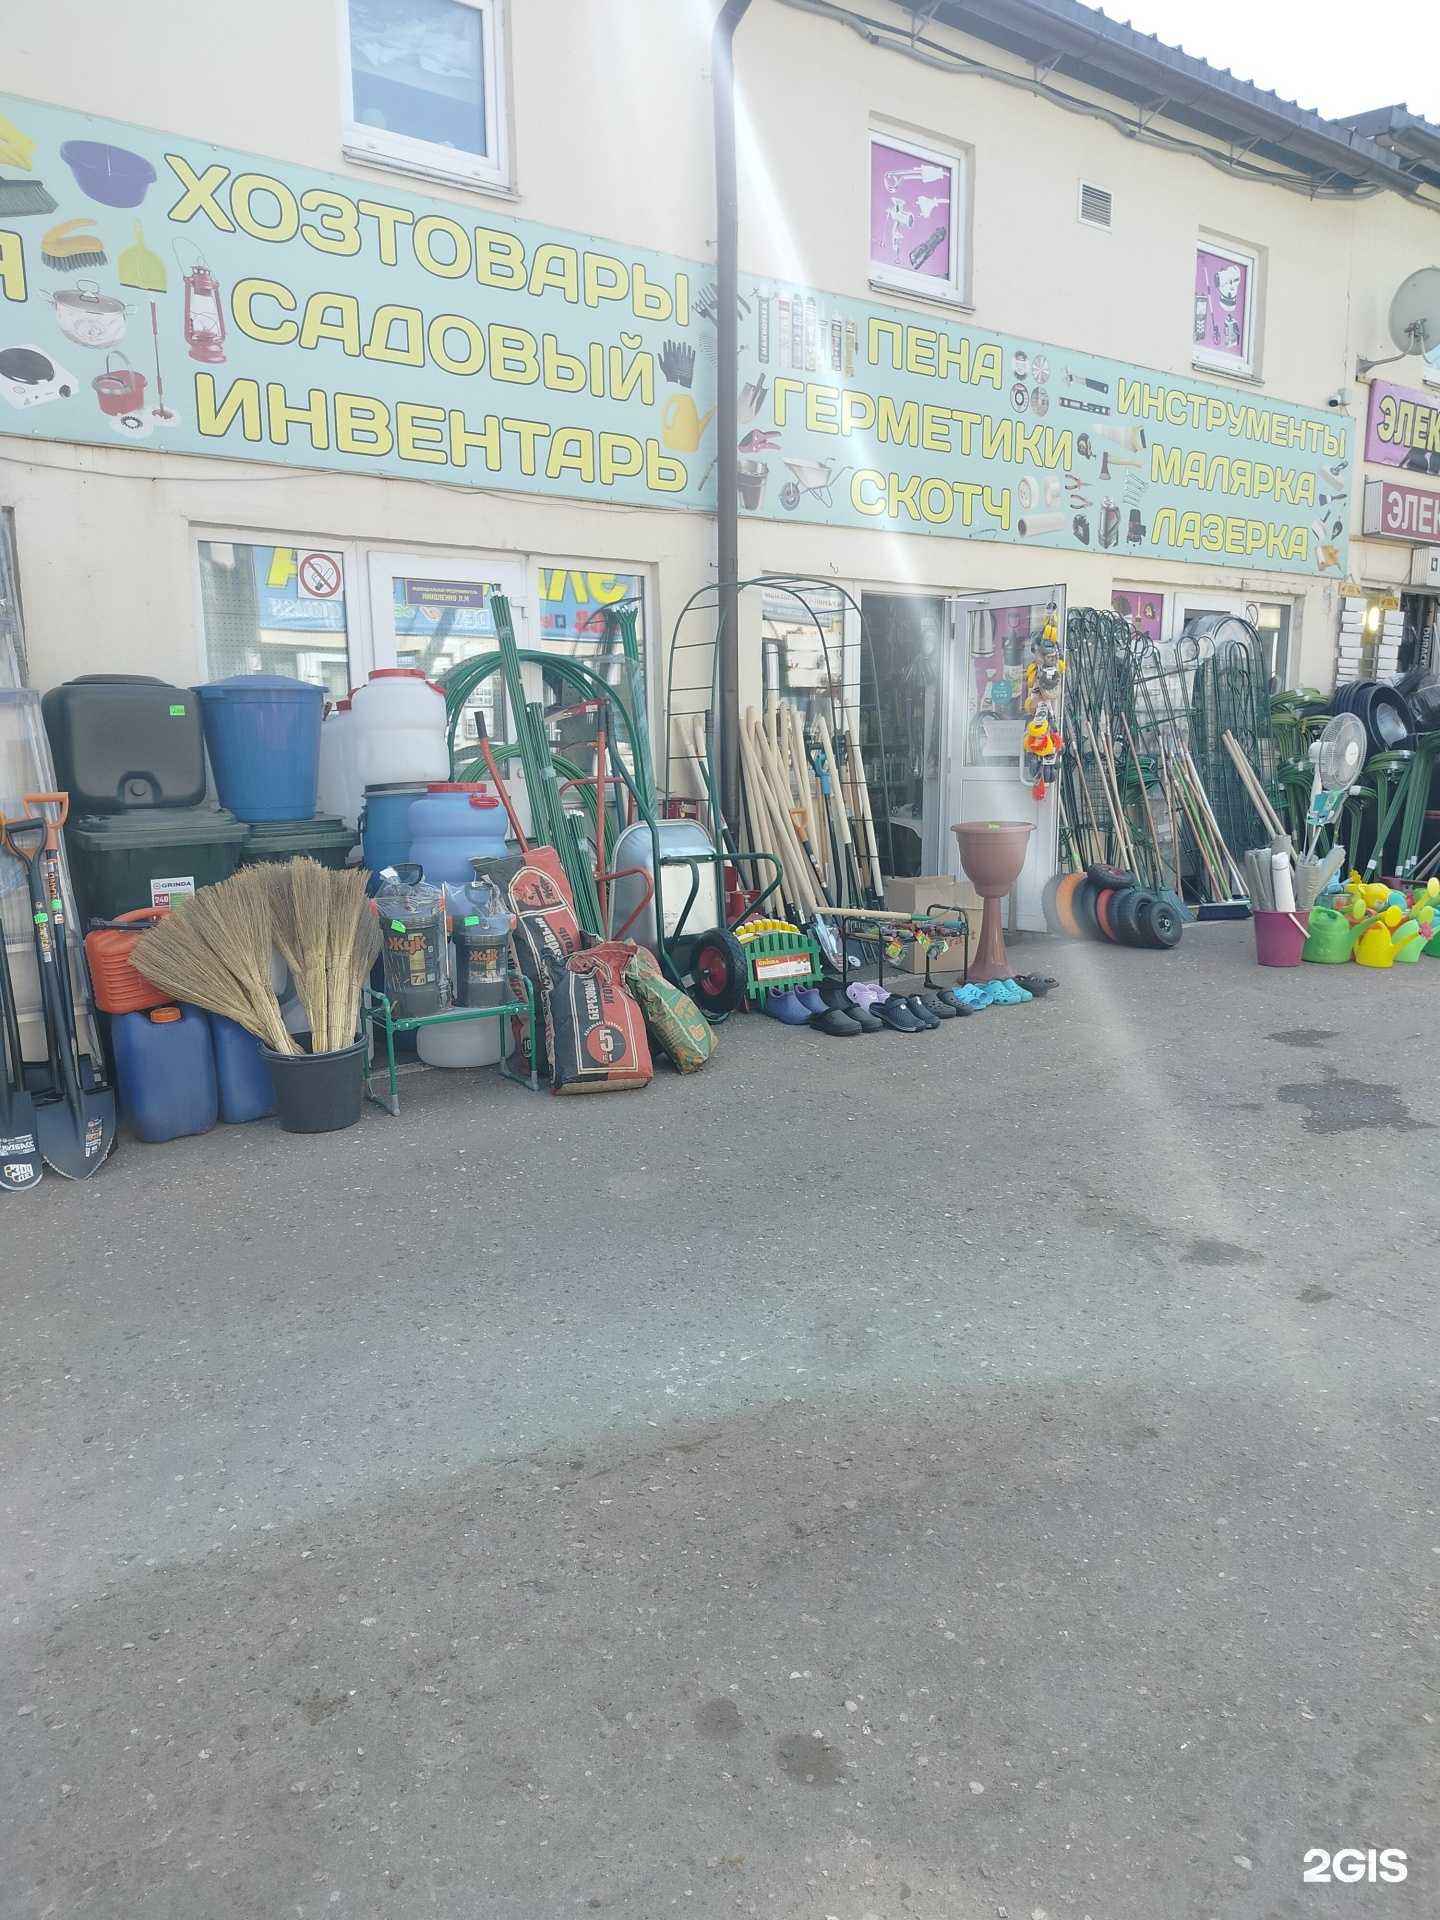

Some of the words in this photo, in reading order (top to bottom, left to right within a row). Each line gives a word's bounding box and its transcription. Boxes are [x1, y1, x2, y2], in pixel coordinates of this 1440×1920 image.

[163, 152, 692, 328] ХОЗТОВАРЫ
[230, 275, 657, 408] САДОВЫЙ
[865, 316, 1004, 391] ПЕНА
[193, 371, 690, 494] ИНВЕНТАРЬ
[772, 376, 1074, 472] ГЕРМЕТИКИ
[1115, 377, 1347, 459] ИНСТРУМЕНТЫ
[848, 467, 1013, 532] СКОТЧ
[1149, 443, 1318, 507] МАЛЯРКА
[1150, 506, 1310, 562] ЛАЗЕРКА
[161, 880, 193, 889] GRINDA
[600, 1029, 614, 1052] 5
